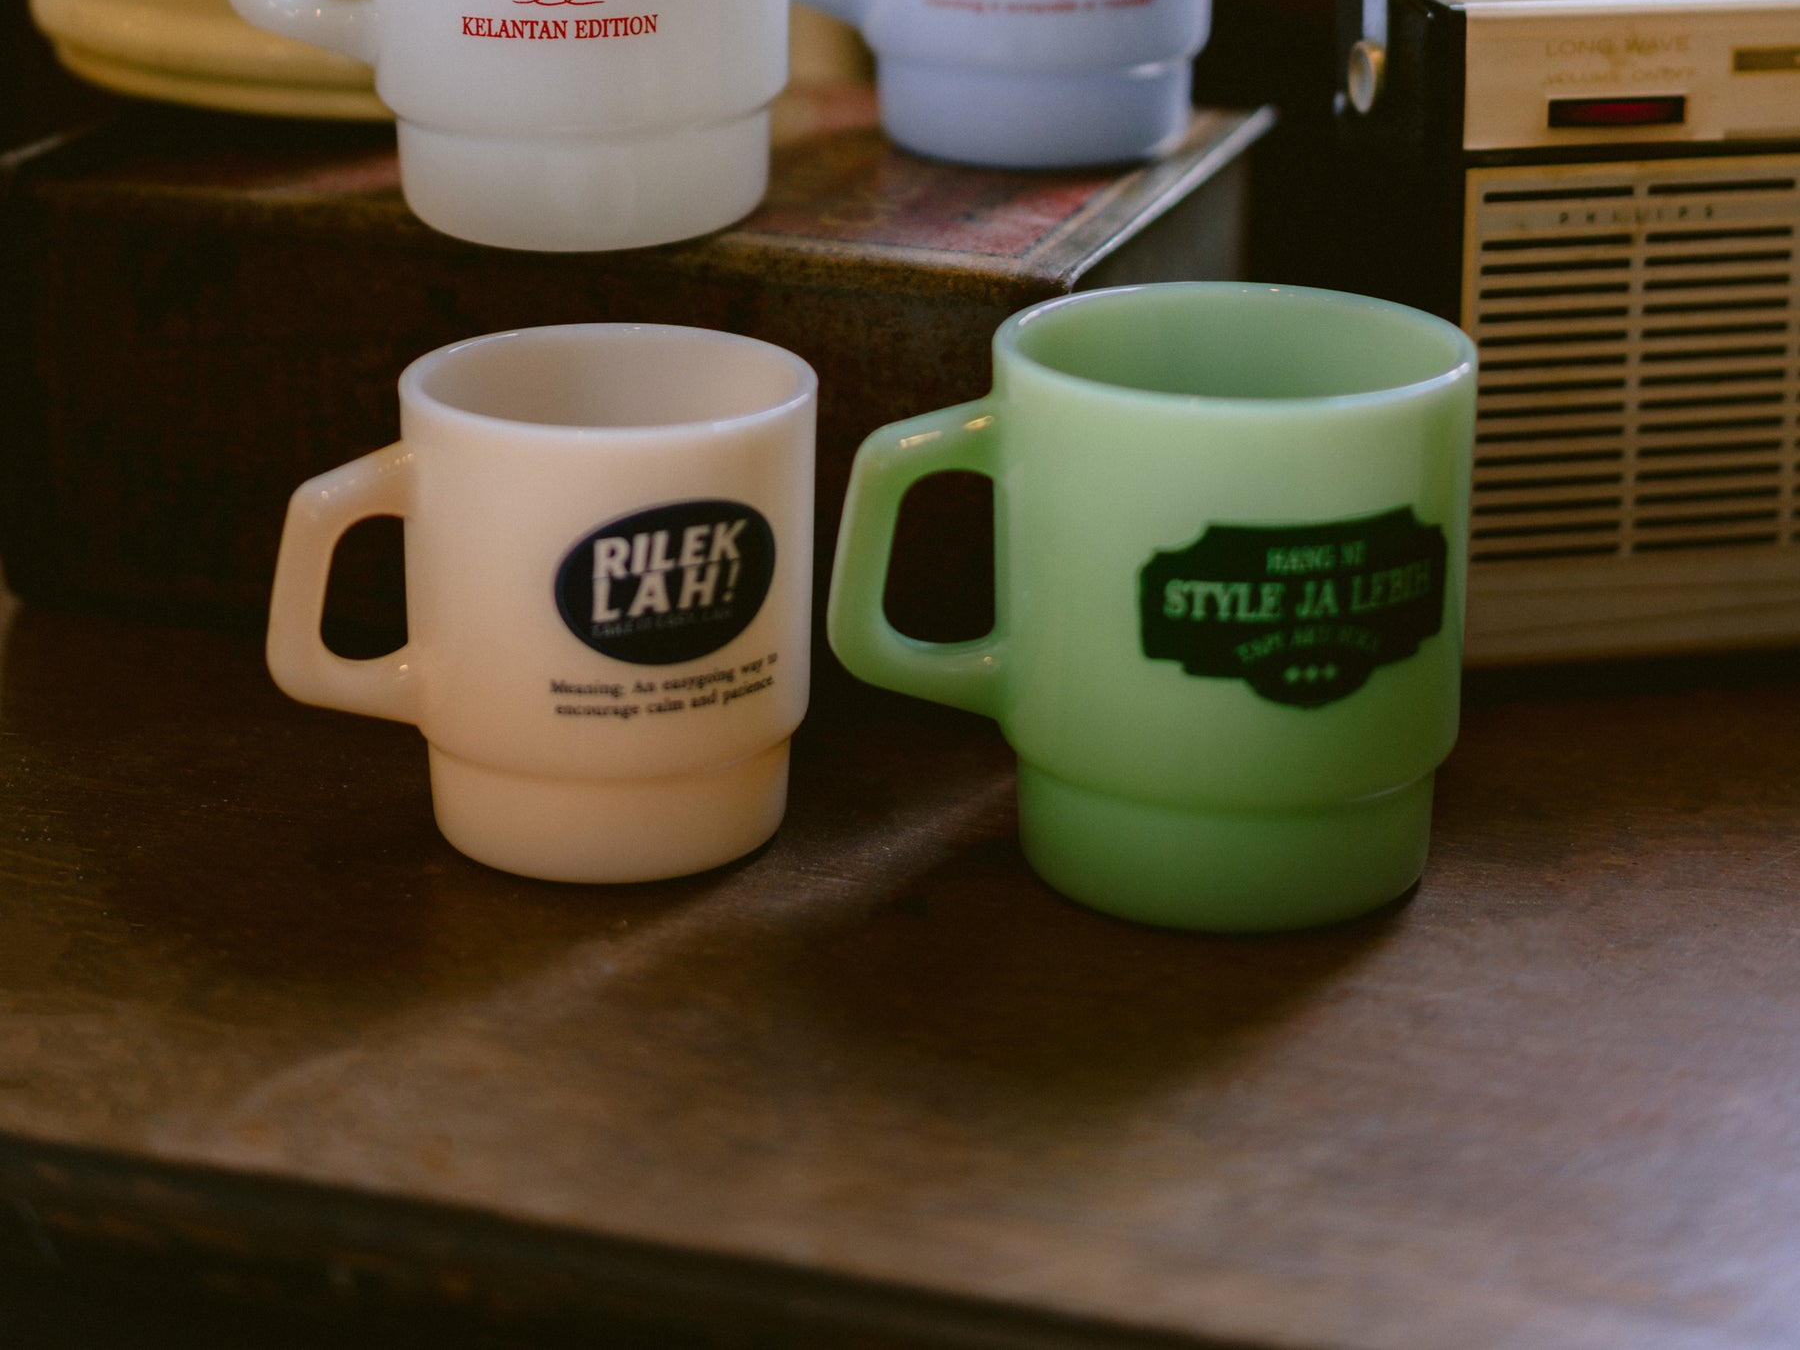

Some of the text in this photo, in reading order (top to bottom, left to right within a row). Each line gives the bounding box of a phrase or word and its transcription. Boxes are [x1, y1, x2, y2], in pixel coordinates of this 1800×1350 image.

[462, 14, 658, 39] KELANTAN EDITION
[592, 518, 748, 579] RILEK
[591, 558, 741, 624] LAH!
[1163, 578, 1286, 622] STYLE
[1295, 579, 1340, 618] JA
[632, 679, 656, 694] An
[662, 666, 735, 689] easygoing
[741, 658, 763, 677] way
[555, 703, 639, 719] encourage
[645, 697, 685, 715] calm
[690, 690, 716, 707] and
